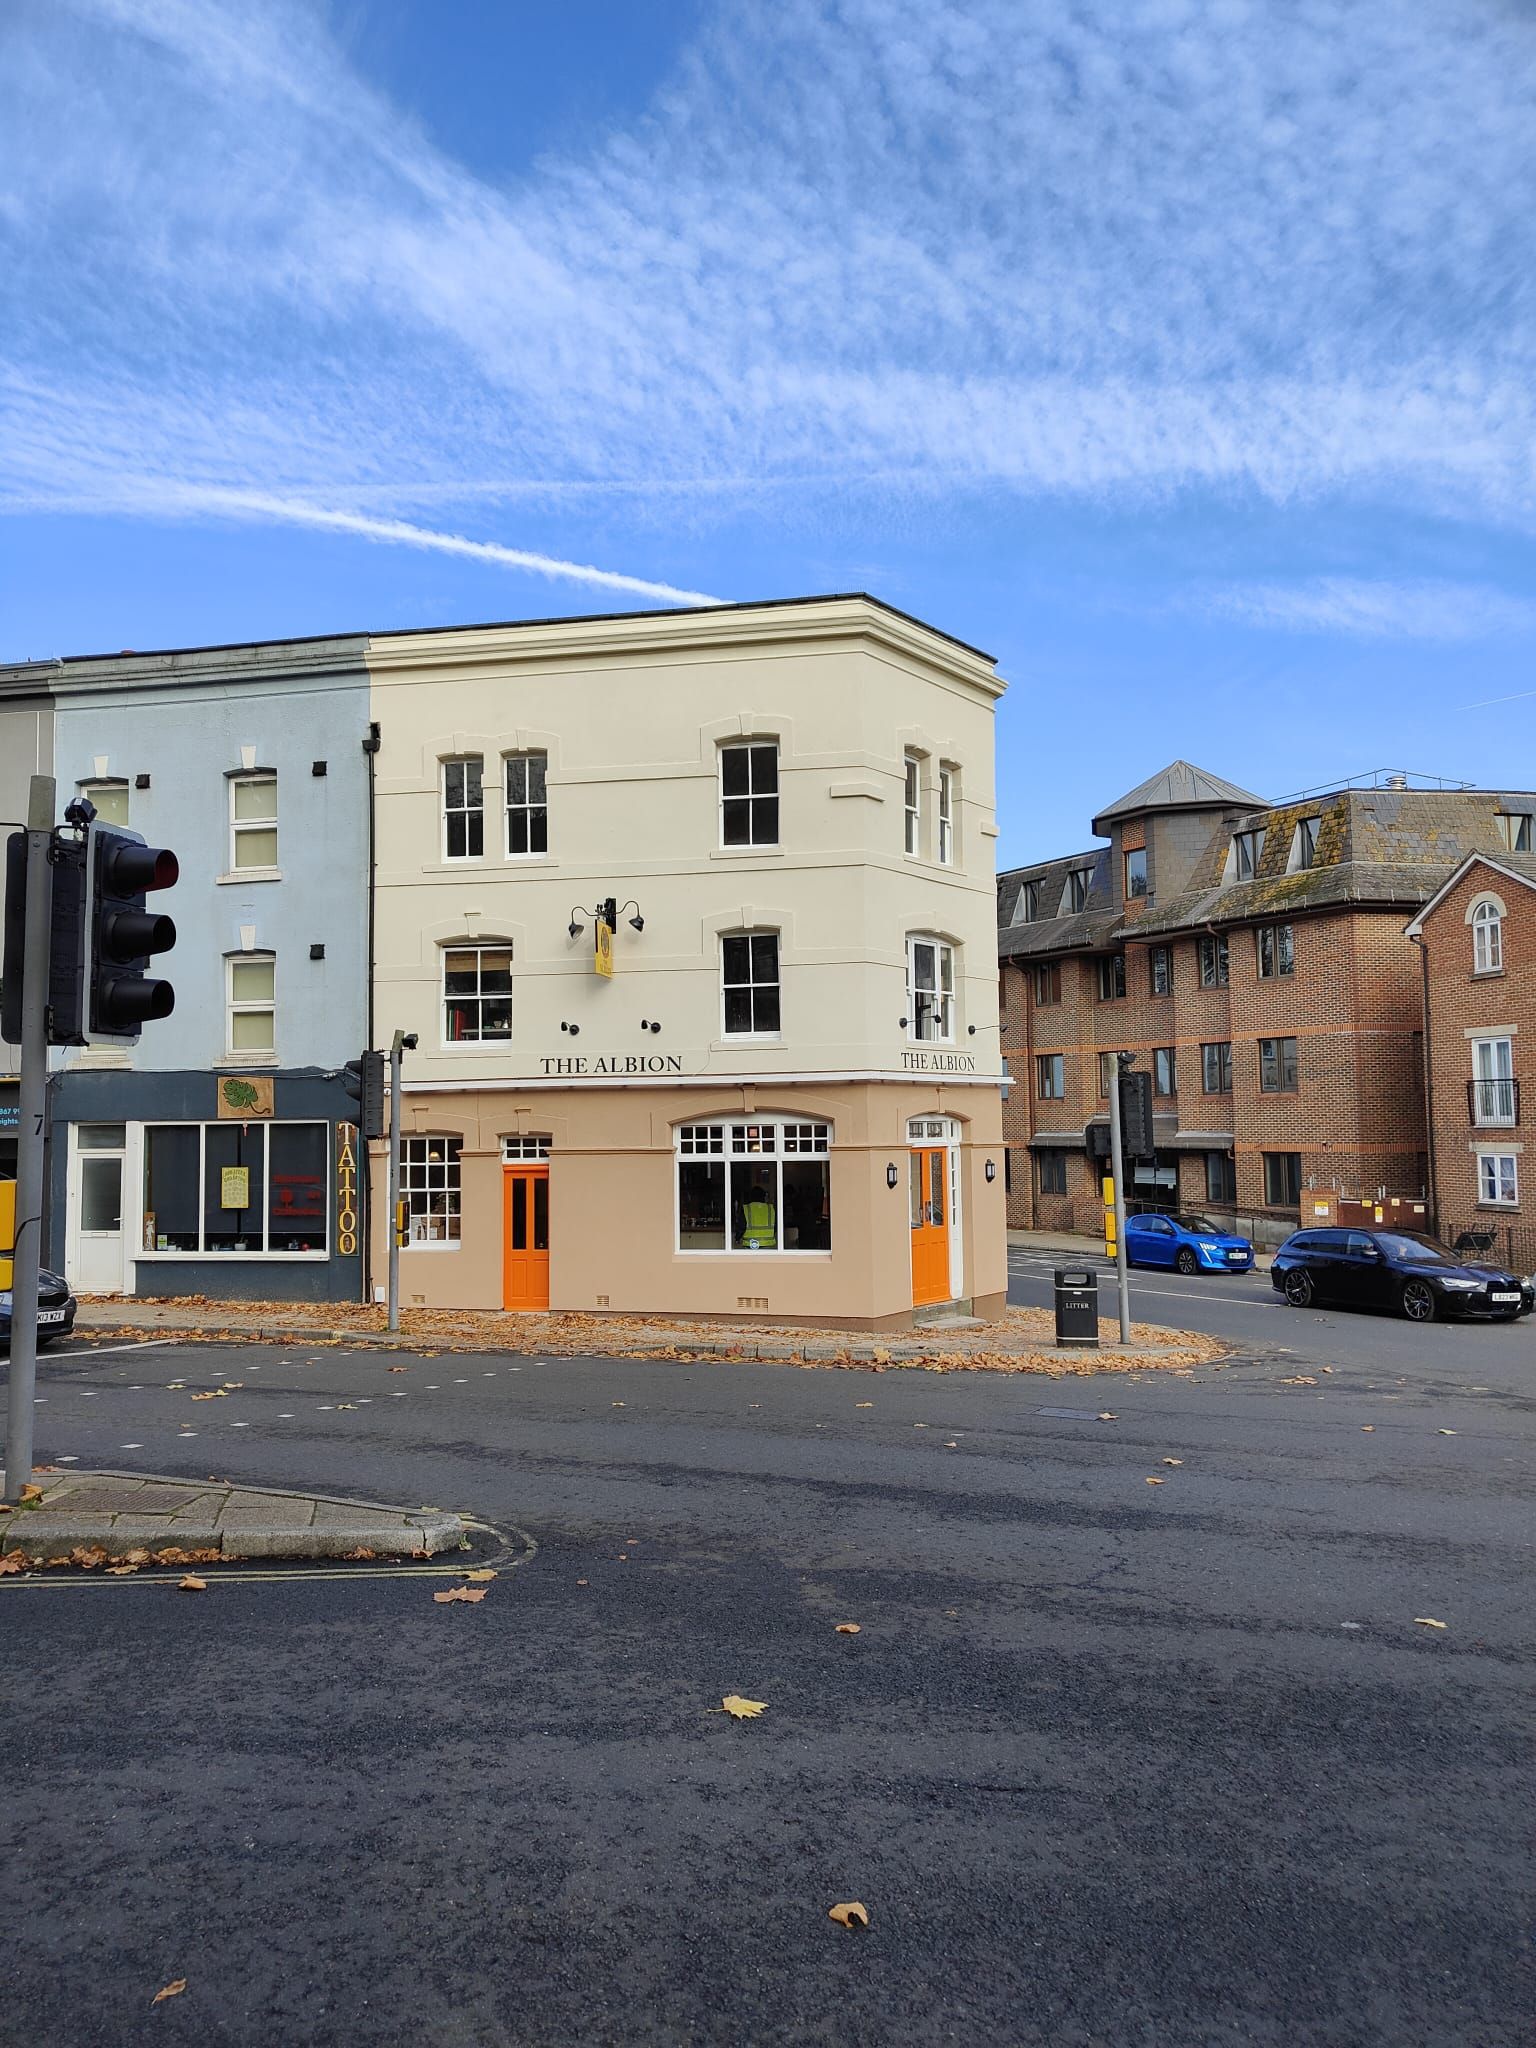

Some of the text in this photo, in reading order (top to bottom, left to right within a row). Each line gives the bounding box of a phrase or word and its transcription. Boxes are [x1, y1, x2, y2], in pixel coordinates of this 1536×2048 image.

[540, 1056, 682, 1074] THE ALBION
[901, 1052, 975, 1071] THE ALBION
[34, 1114, 44, 1136] 7
[338, 1121, 357, 1255] TATTOO
